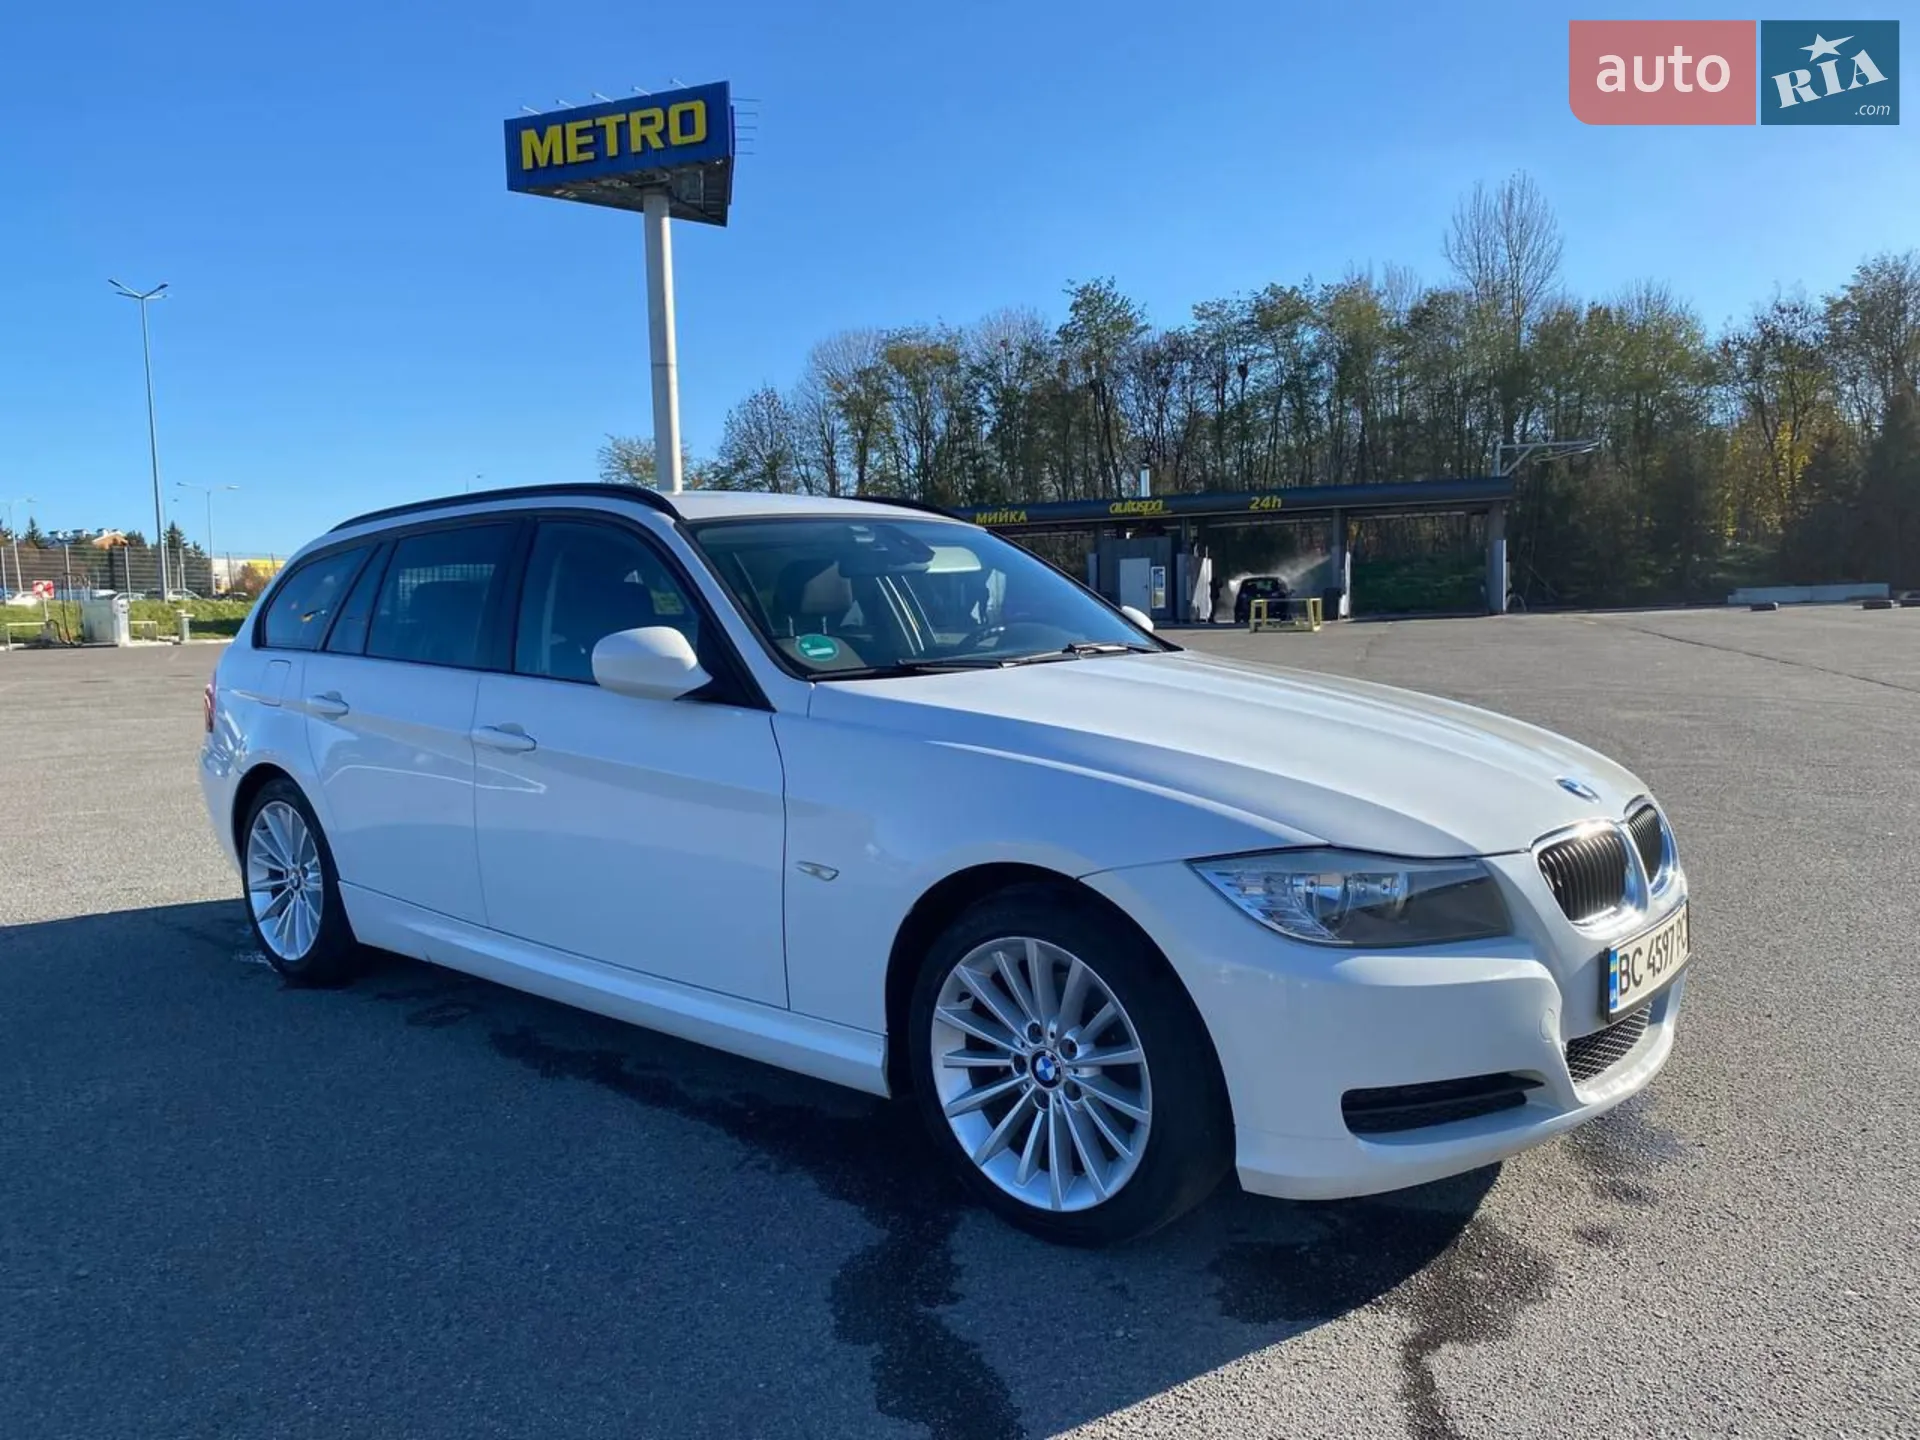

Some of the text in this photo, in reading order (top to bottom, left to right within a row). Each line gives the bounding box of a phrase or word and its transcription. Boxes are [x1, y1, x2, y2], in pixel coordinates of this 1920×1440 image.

[521, 99, 707, 170] METRO
[1109, 500, 1163, 516] autospa
[1249, 495, 1282, 510] 24h
[975, 507, 1028, 525] МИЙКА
[1619, 946, 1643, 997] BC
[1647, 924, 1675, 978] 4597
